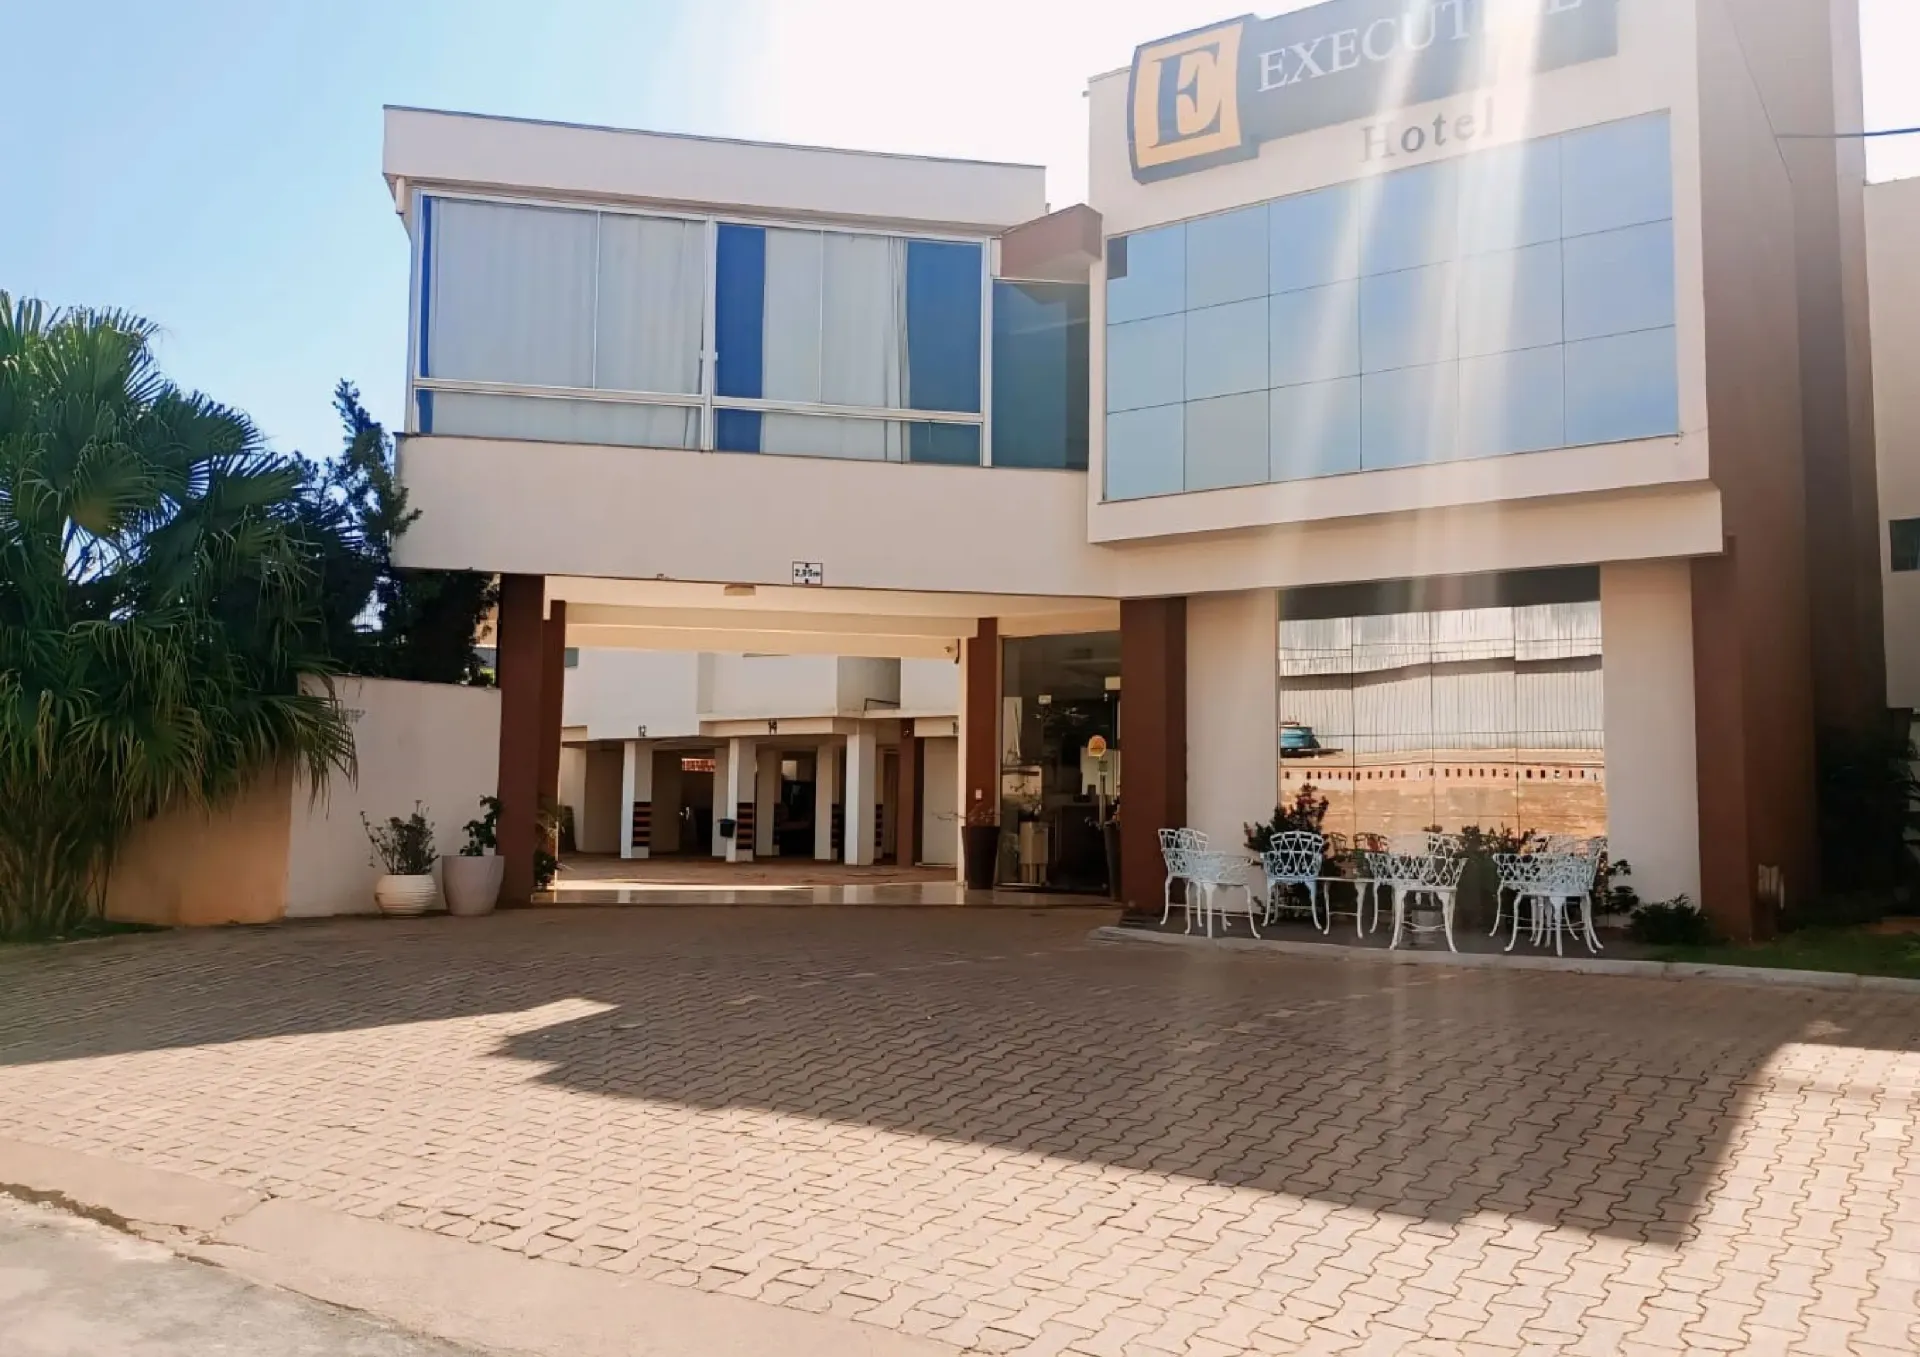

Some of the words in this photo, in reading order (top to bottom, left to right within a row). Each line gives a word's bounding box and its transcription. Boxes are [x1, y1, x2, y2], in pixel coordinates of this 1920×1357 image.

[1256, 0, 1583, 92] EXECUT
[1148, 42, 1221, 149] E
[1358, 95, 1495, 162] Hotel
